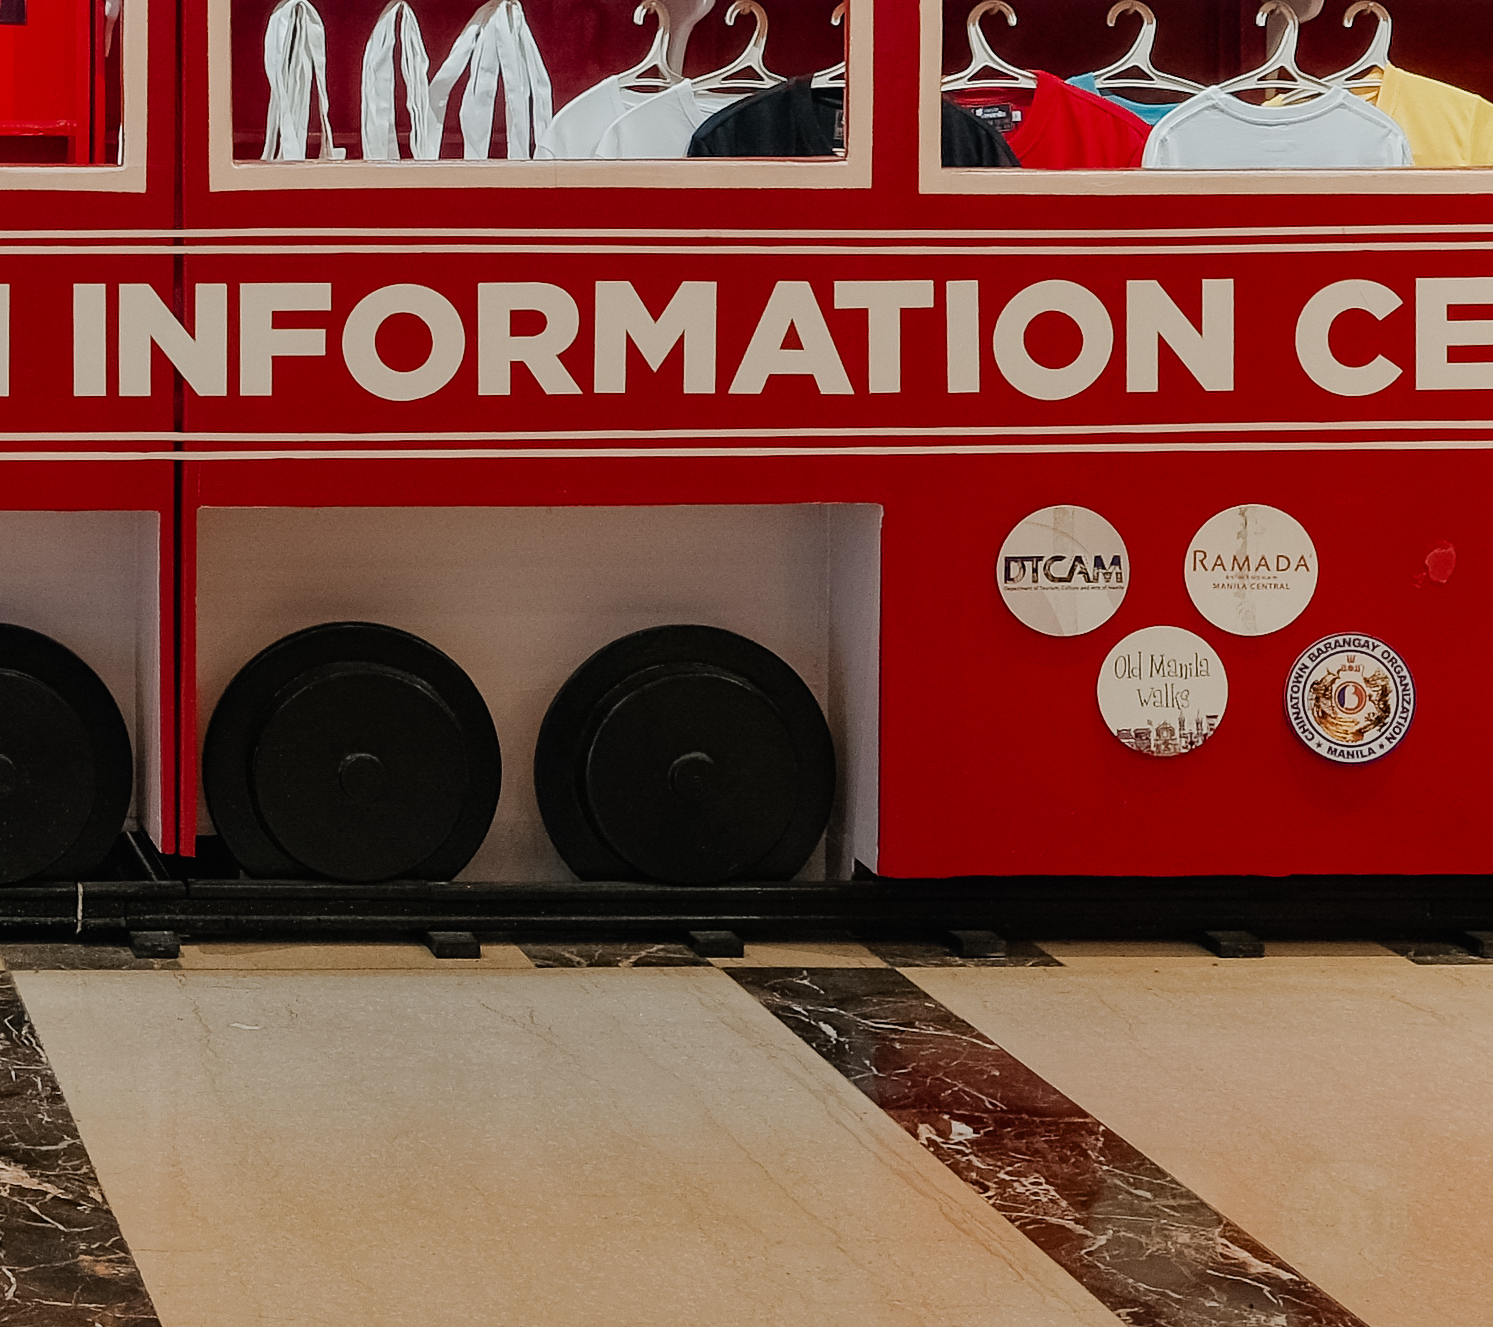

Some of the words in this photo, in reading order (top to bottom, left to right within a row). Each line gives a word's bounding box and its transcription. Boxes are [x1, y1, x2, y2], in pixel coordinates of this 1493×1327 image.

[73, 279, 1234, 401] INFORMATION
[1004, 555, 1123, 584] DTCAM
[1192, 550, 1310, 572] RAMADA
[1114, 651, 1142, 680] Old
[1149, 652, 1211, 680] Manila
[1289, 662, 1315, 743] CHINATOWN
[1307, 637, 1380, 662] BARANGAY
[1380, 649, 1412, 745] ORGANIZATION
[1326, 746, 1377, 759] MANILA
